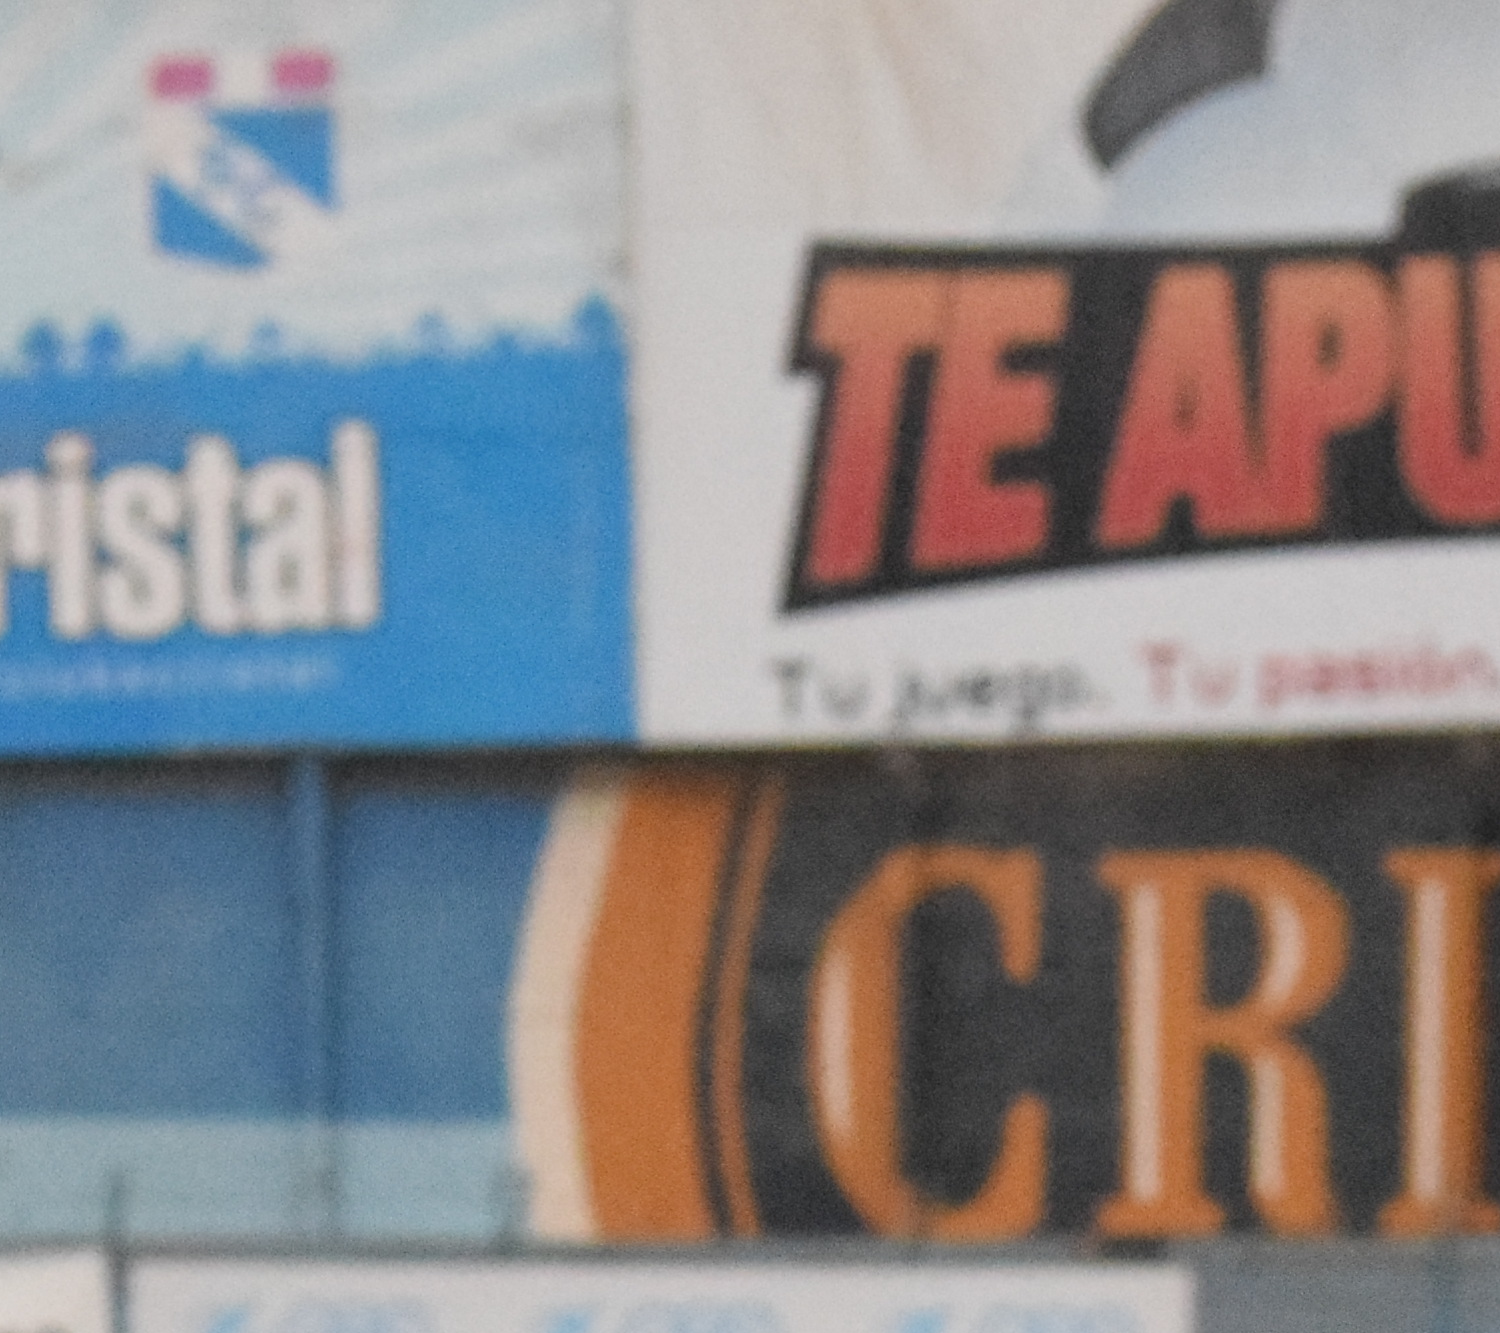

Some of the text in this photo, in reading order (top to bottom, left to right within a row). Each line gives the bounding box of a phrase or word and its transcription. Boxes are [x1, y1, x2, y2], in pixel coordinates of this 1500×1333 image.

[800, 262, 1075, 590] TE
[773, 658, 870, 718] Tu
[1138, 640, 1240, 706] Tu
